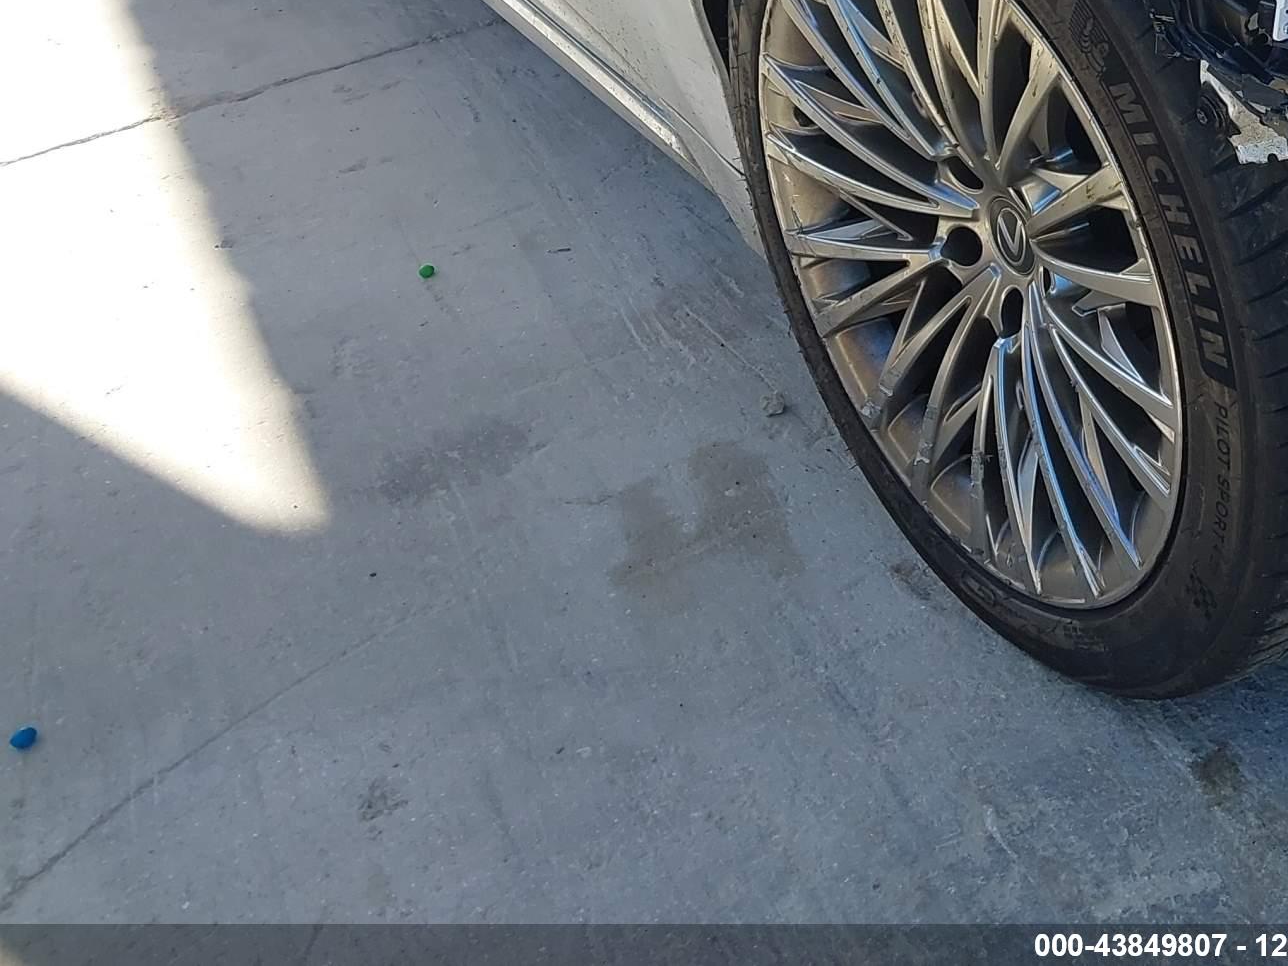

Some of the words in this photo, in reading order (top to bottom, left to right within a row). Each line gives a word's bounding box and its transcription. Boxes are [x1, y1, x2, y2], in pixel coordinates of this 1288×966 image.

[1108, 82, 1229, 370] MICHELIN
[1214, 401, 1231, 472] PILOT
[1212, 475, 1231, 543] SPORT
